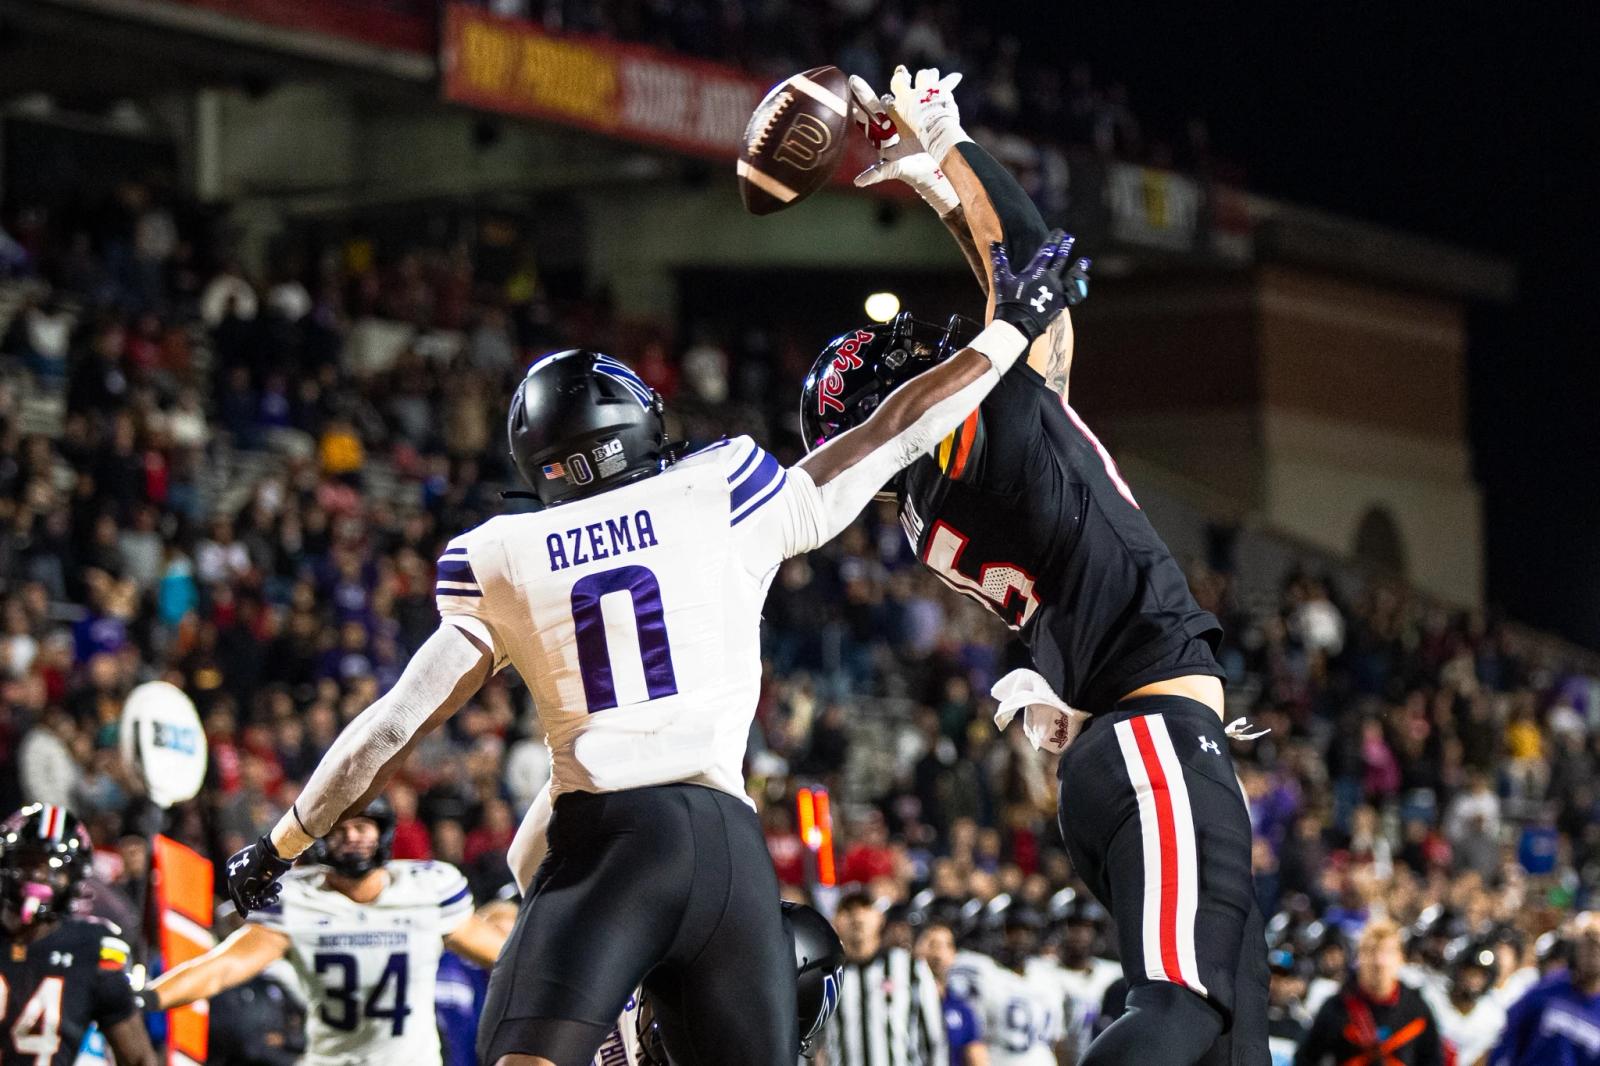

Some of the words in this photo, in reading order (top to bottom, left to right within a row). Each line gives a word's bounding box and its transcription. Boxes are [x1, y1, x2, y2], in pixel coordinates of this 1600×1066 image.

[818, 329, 876, 416] Terps
[566, 453, 594, 486] 0
[546, 509, 659, 572] AZEMA
[570, 564, 679, 714] 0
[314, 951, 411, 1038] 34
